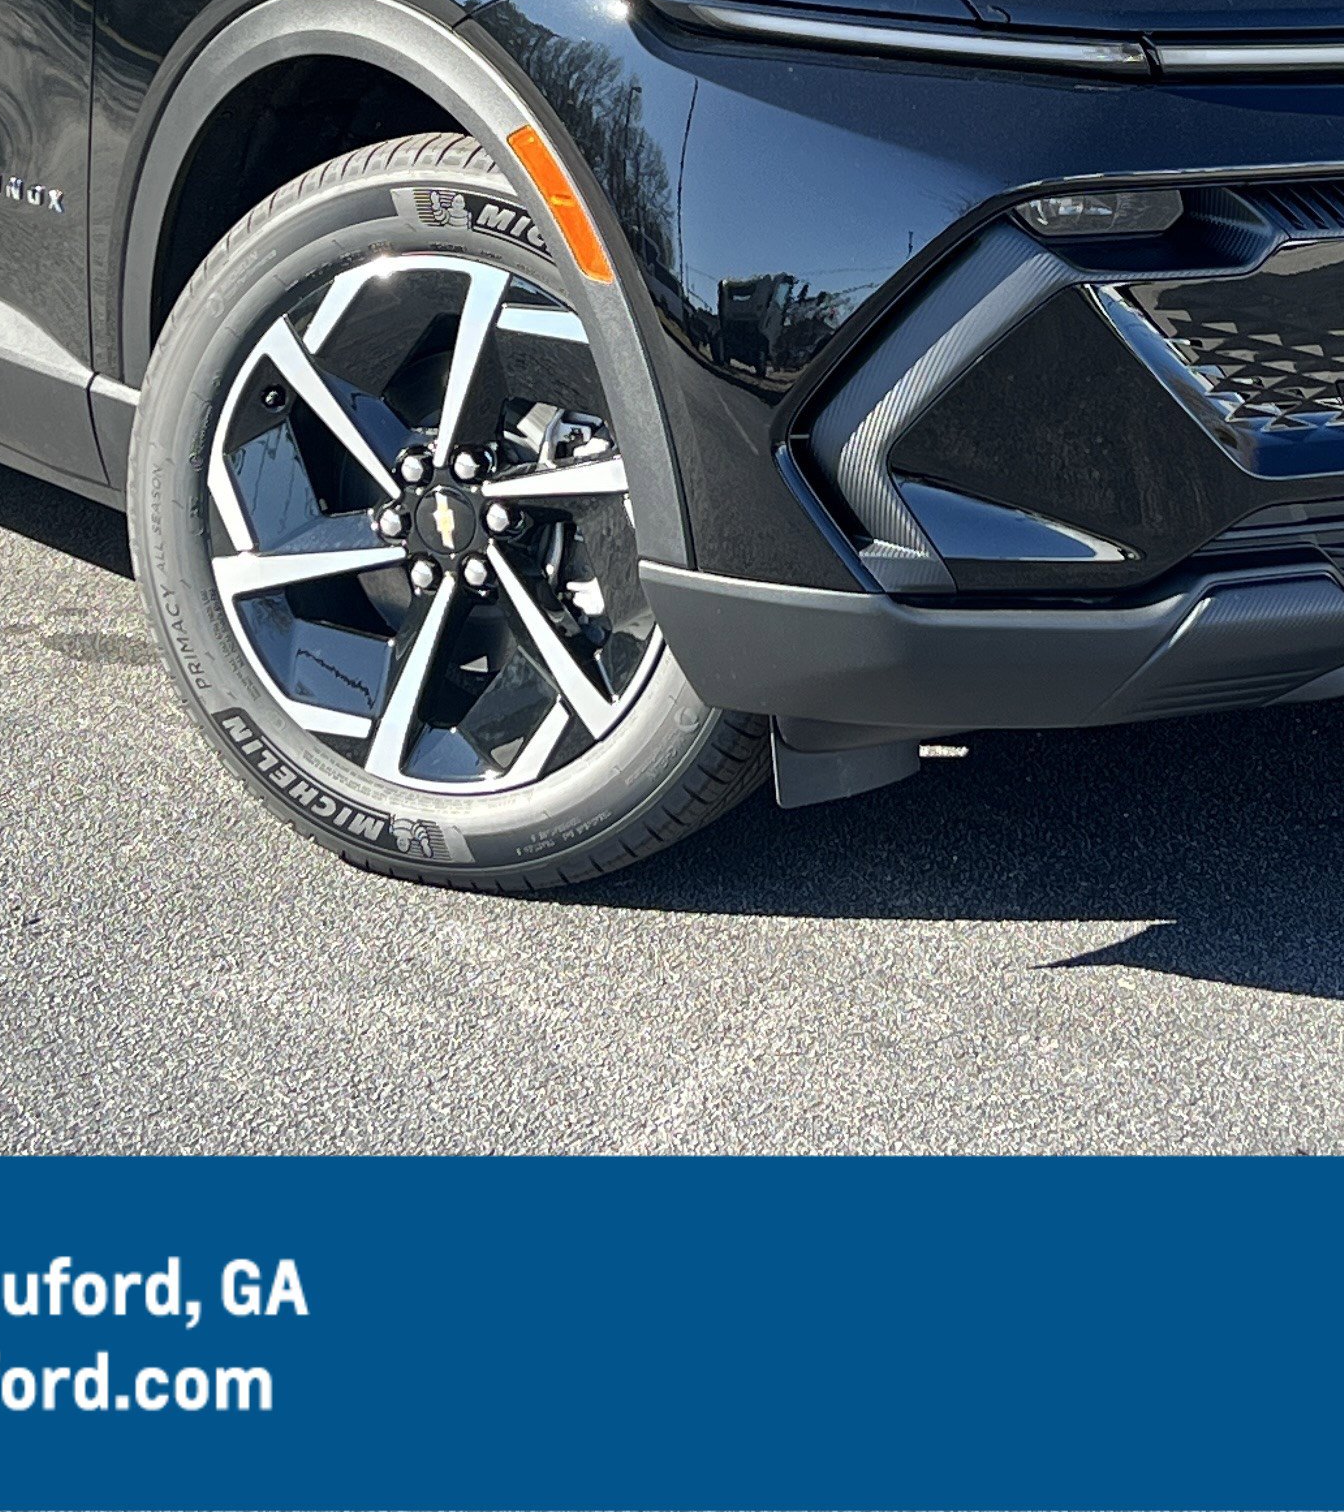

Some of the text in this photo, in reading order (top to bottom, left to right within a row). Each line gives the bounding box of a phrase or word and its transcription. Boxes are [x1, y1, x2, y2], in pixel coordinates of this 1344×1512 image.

[150, 464, 213, 691] PRIMACY ALL SEASON
[222, 715, 387, 842] MICHELIN
